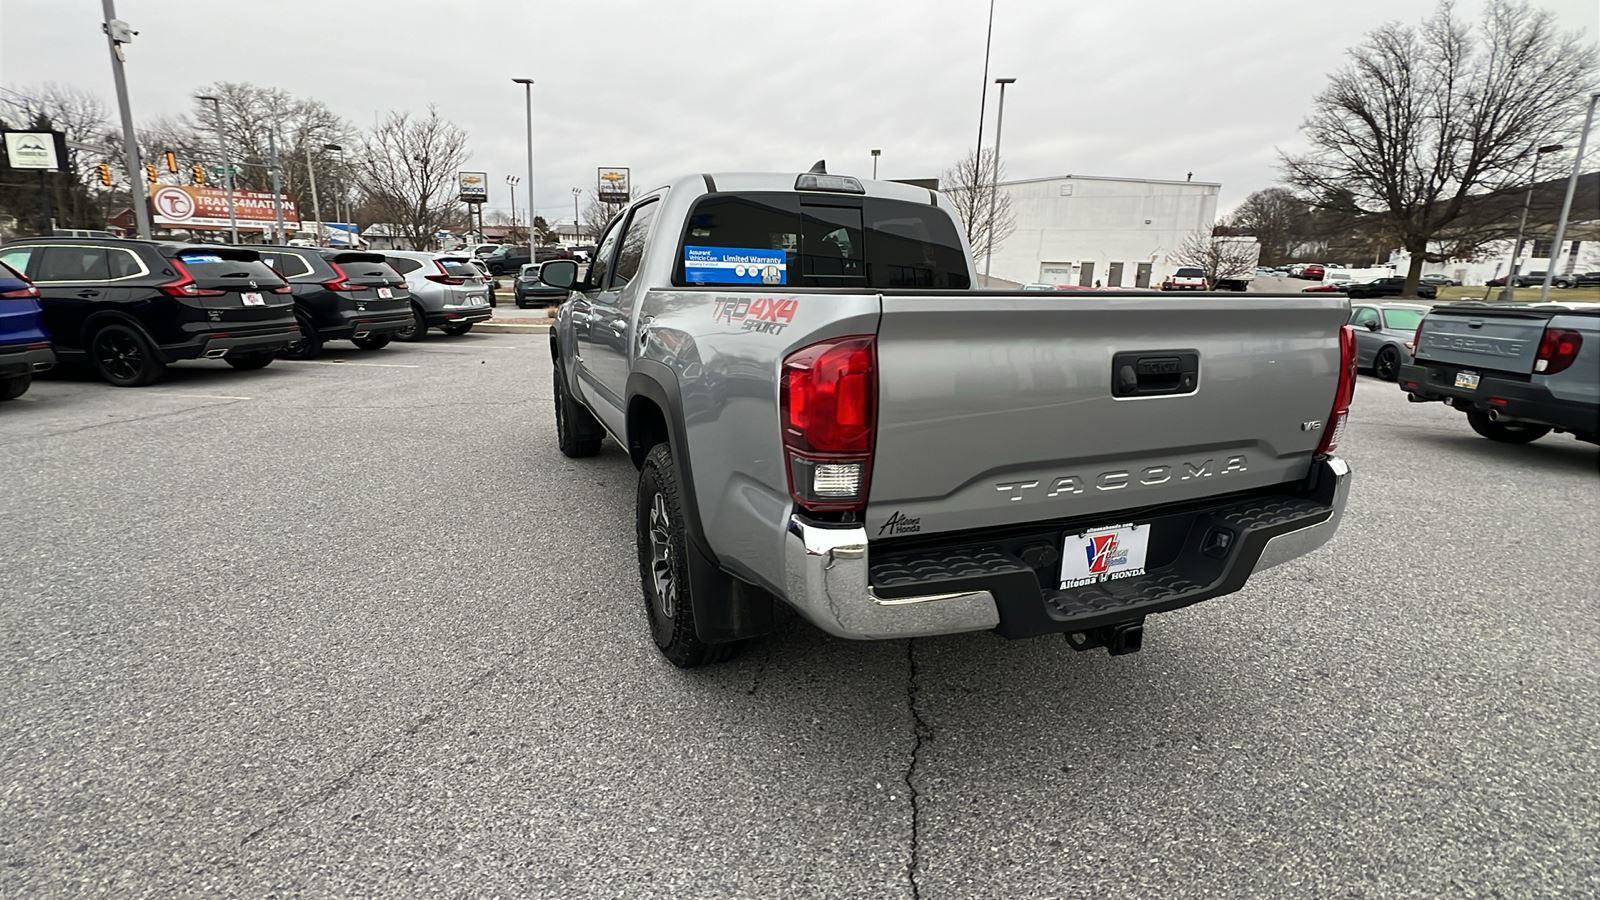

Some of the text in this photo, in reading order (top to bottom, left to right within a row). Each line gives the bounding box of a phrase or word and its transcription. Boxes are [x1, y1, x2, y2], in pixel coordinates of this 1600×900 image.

[722, 255, 782, 265] Limited Warranty
[712, 296, 751, 326] TRD
[740, 319, 788, 335] SPORT
[1301, 420, 1321, 431] V6
[996, 454, 1247, 501] TACOMA
[896, 525, 920, 533] Honda
[1060, 577, 1097, 590] Altoona
[1111, 568, 1146, 580] HONDA
